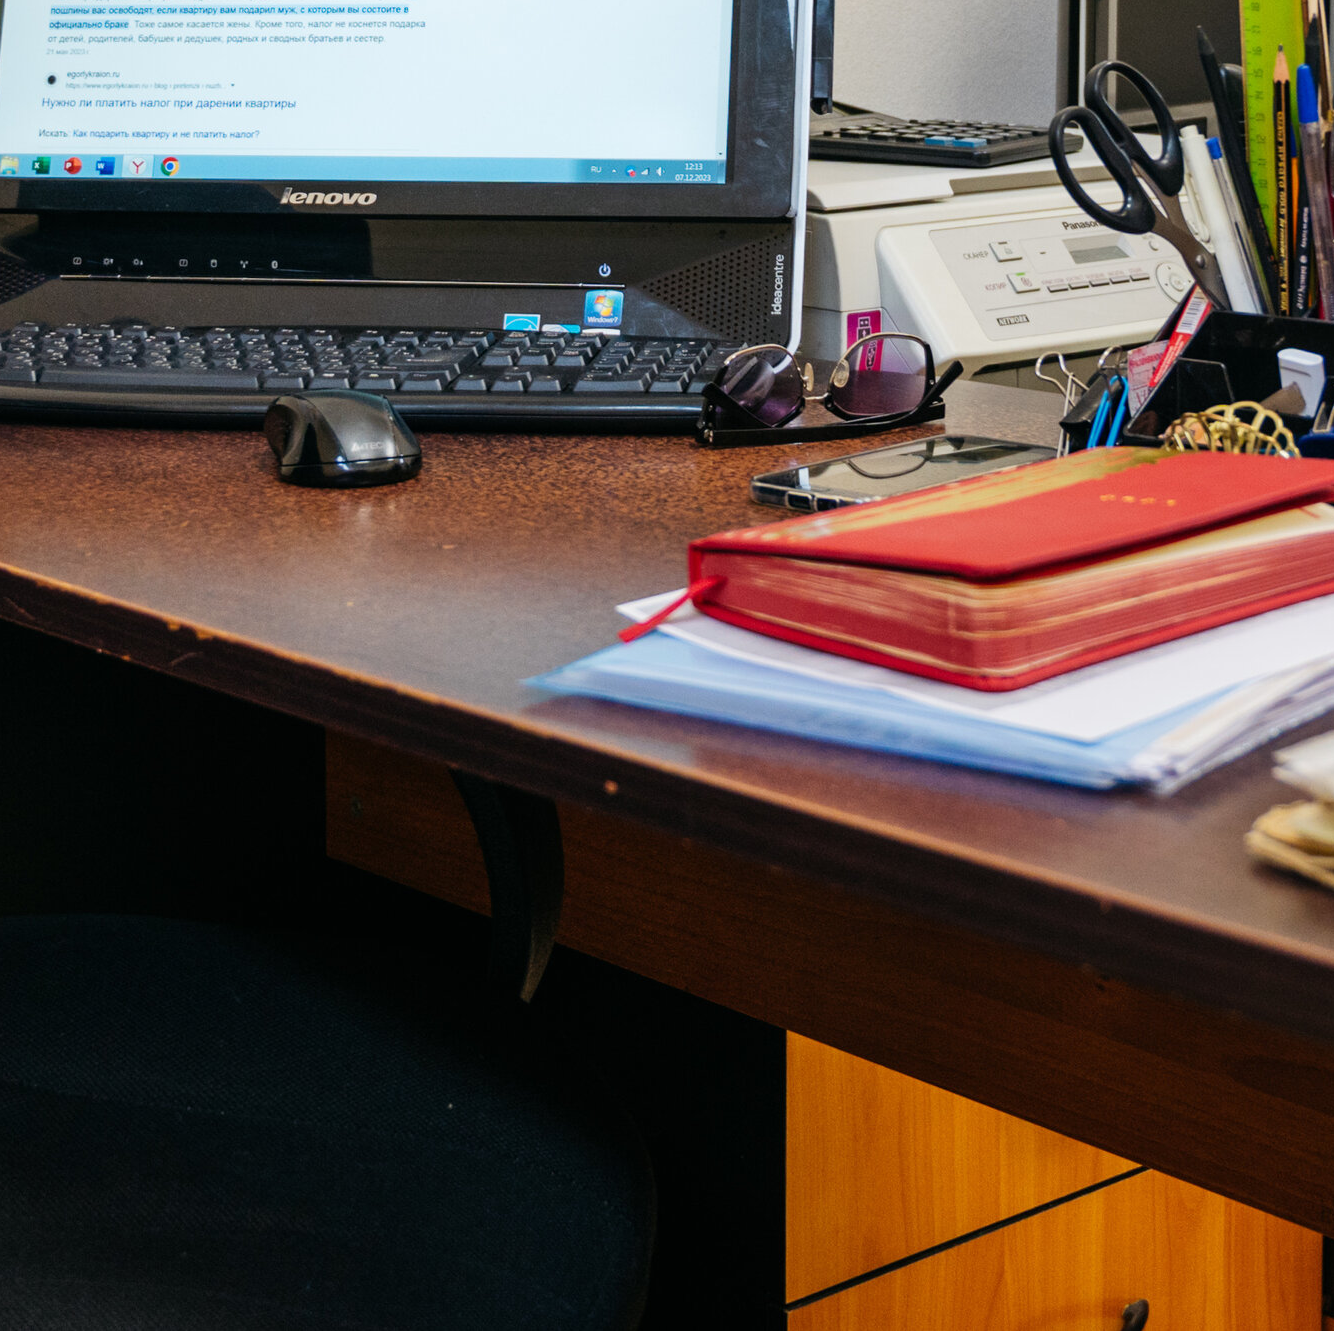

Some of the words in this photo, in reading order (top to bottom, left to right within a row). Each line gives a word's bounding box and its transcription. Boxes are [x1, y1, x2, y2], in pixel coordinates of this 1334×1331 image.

[50, 7, 90, 16] пошлины
[92, 7, 107, 15] вас
[109, 5, 155, 17] освободят,
[157, 7, 177, 15] если
[179, 6, 218, 17] квартиру
[238, 6, 276, 16] подарил
[277, 6, 298, 16] муж,
[308, 6, 346, 16] которым
[362, 6, 402, 14] состоите
[49, 19, 103, 30] официально
[41, 98, 77, 110] Нужно
[79, 99, 93, 108] ли
[95, 98, 138, 109] платить
[140, 99, 171, 109] налог
[174, 99, 194, 110] при
[195, 99, 243, 110] дарении
[245, 99, 297, 111] квартиры
[591, 166, 603, 174] RU
[685, 163, 704, 171] 12:13
[675, 173, 712, 183] 07.12.2023
[279, 186, 378, 206] lenovo
[1061, 220, 1101, 231] Panaso
[770, 253, 786, 316] ideacentre
